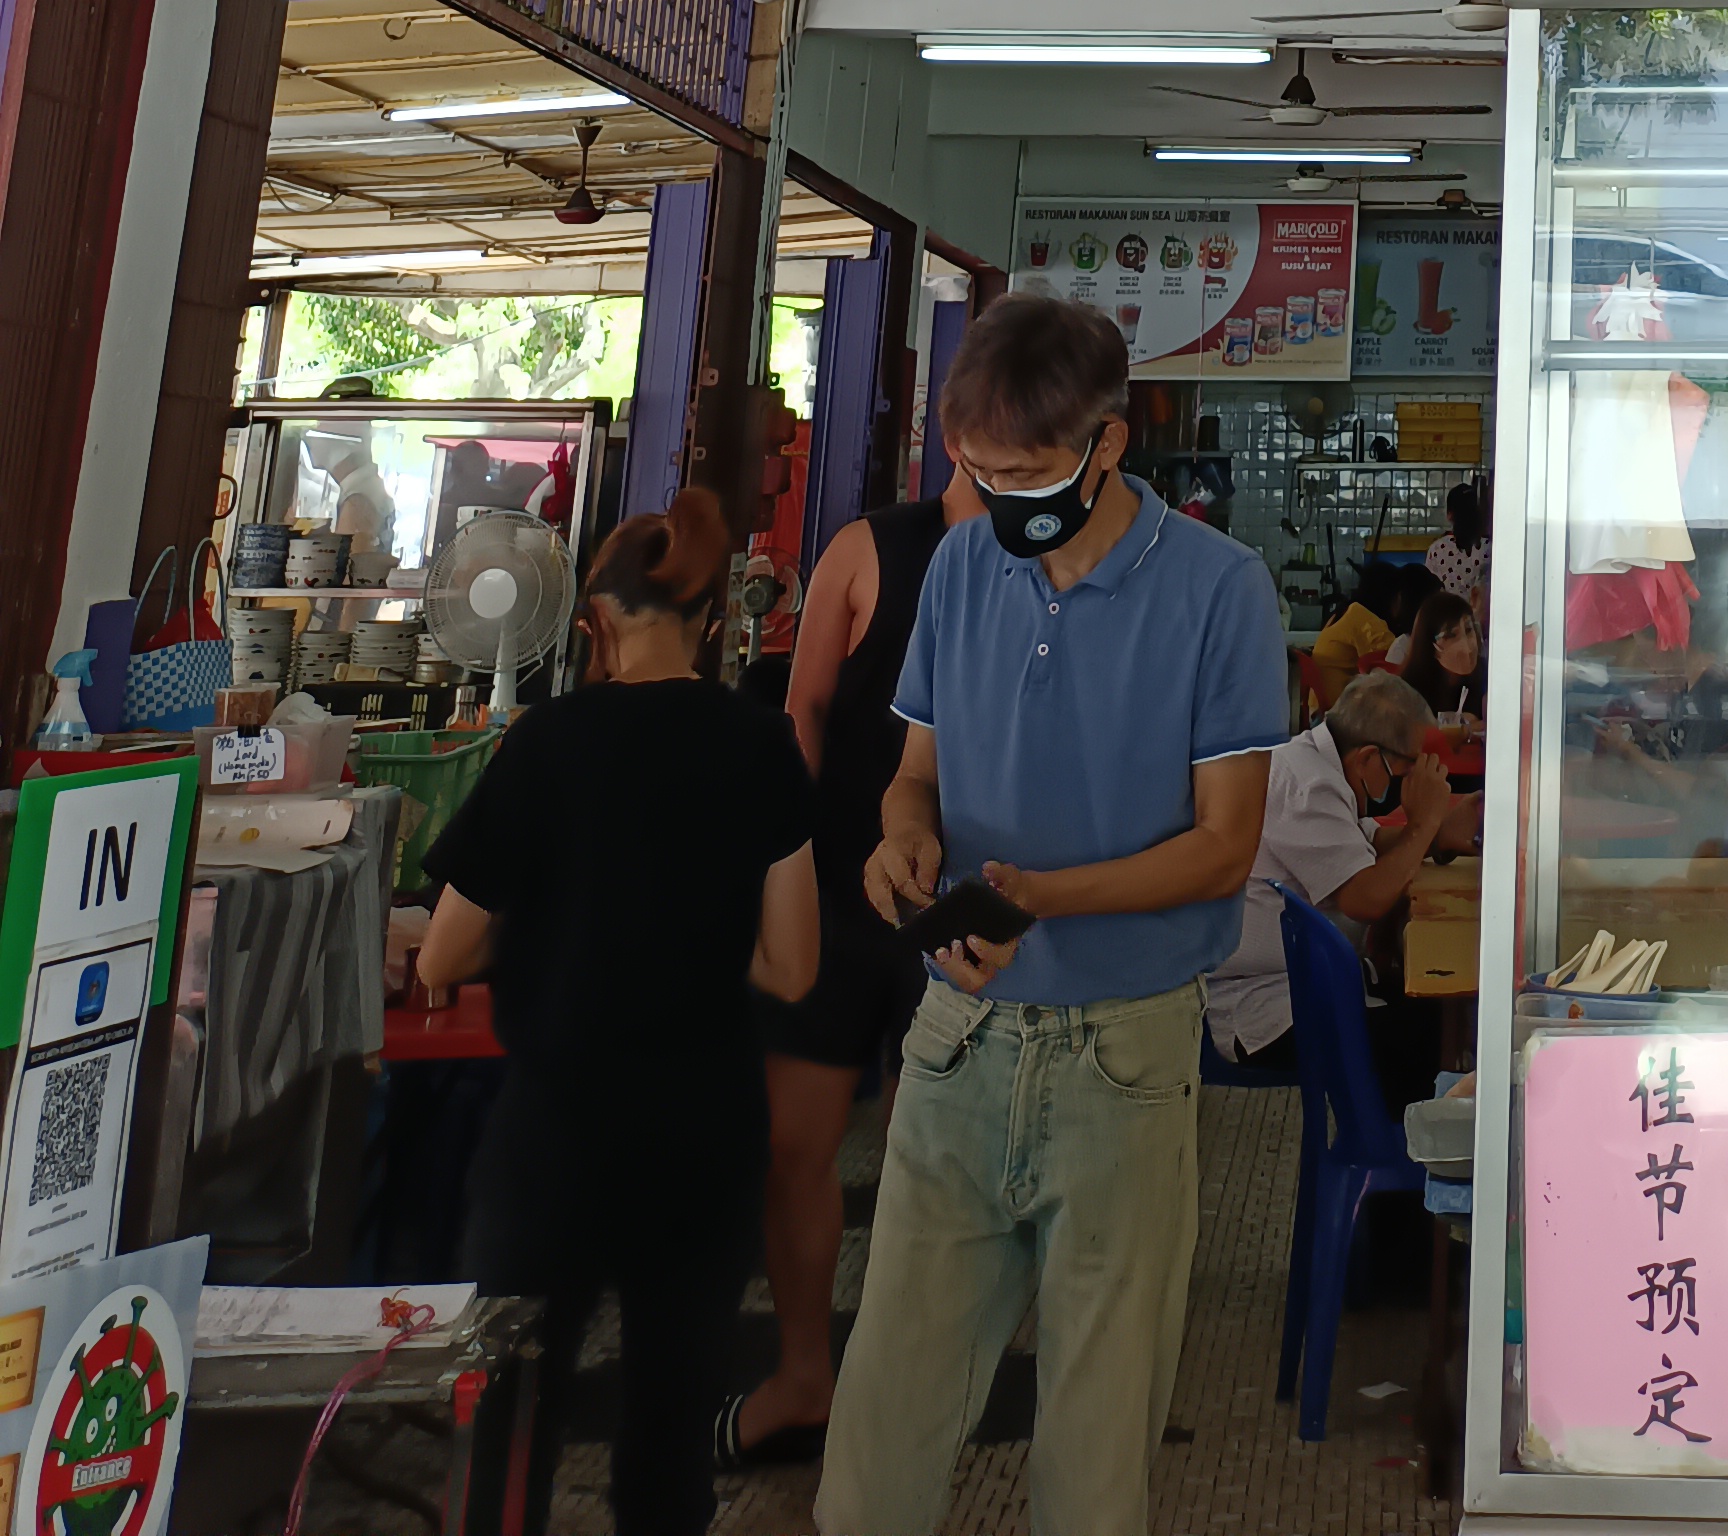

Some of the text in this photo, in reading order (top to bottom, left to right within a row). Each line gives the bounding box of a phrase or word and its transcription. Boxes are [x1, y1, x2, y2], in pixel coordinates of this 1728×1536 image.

[1025, 209, 1171, 221] RESTORAN MAKANAN SUN SEA
[1277, 222, 1339, 239] MARIGOLD
[1376, 230, 1449, 245] RESTORAN
[1355, 337, 1382, 346] APPLE
[1414, 337, 1449, 346] CARROT
[1421, 347, 1443, 356] MILK
[79, 821, 138, 911] IN
[1627, 1046, 1713, 1444] 佳节预定
[71, 1455, 132, 1492] Entrance
